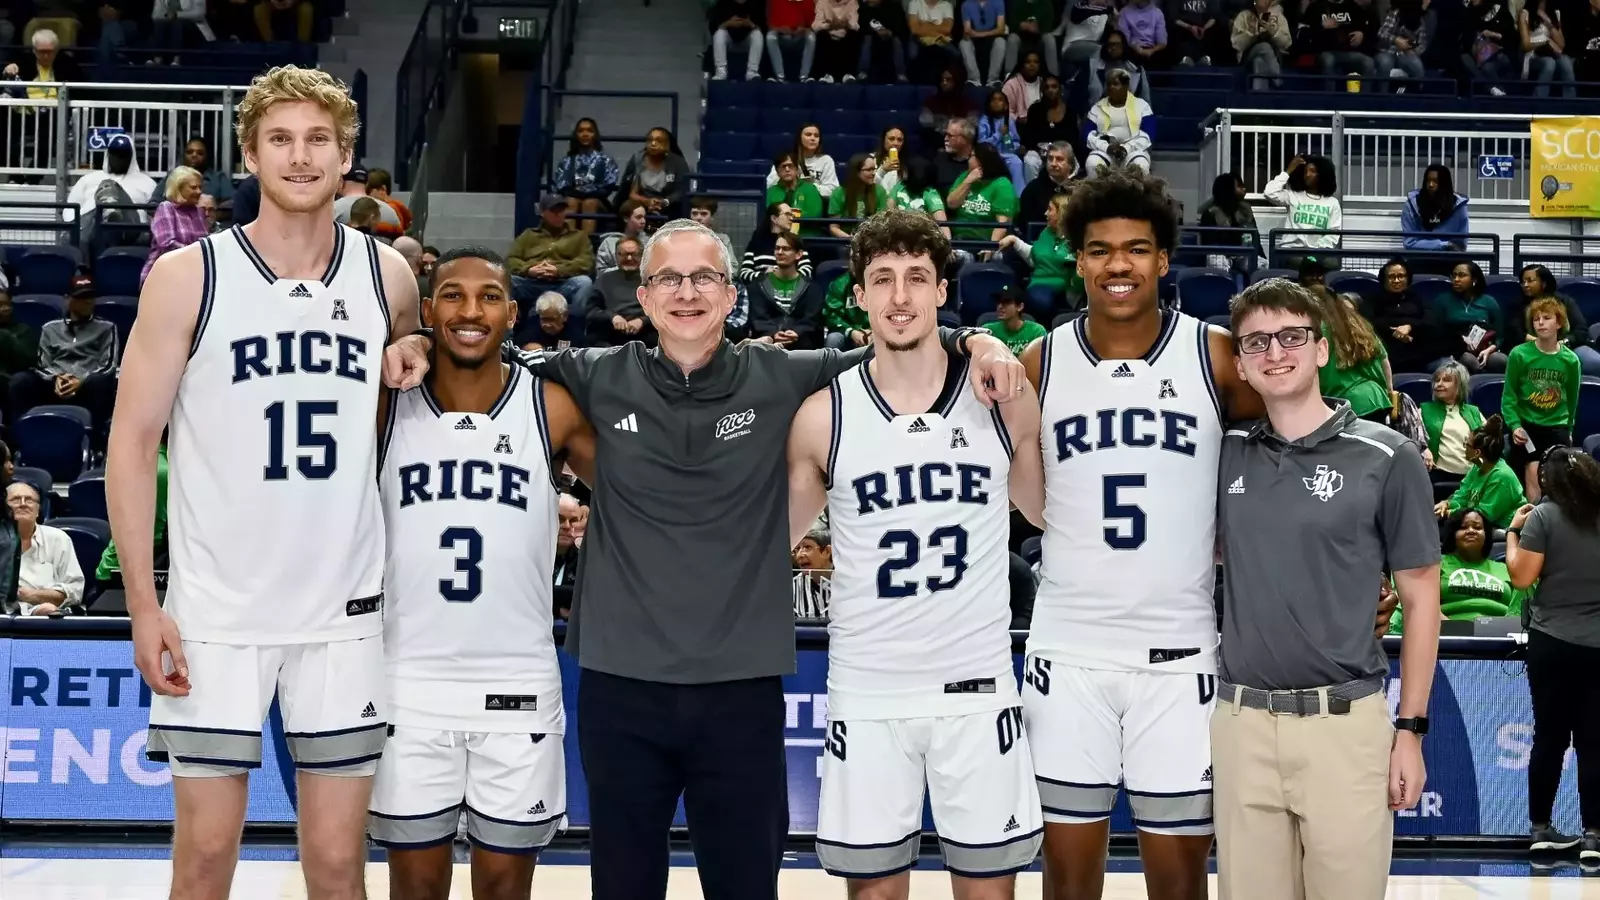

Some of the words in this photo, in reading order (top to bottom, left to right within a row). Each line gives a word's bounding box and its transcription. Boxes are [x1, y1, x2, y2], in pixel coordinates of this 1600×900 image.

[1321, 12, 1351, 22] NASA
[507, 20, 534, 37] EXIT
[1297, 203, 1330, 216] MEAN
[1293, 211, 1328, 230] GREEN
[331, 299, 349, 320] A
[230, 330, 368, 385] RICE
[1158, 379, 1178, 399] A
[454, 423, 478, 431] adidas
[715, 408, 756, 438] Rice
[907, 425, 931, 434] adidas
[263, 400, 339, 481] 15
[494, 434, 513, 454] A
[723, 428, 752, 441] BASKETBALL
[950, 427, 969, 449] A
[1053, 407, 1198, 464] RICE
[399, 459, 530, 512] RICE
[851, 462, 992, 516] RICE
[1102, 473, 1147, 551] 5
[438, 525, 484, 603] 3
[876, 523, 970, 600] 23
[1448, 579, 1473, 588] MEAN
[1474, 581, 1505, 594] GREEN
